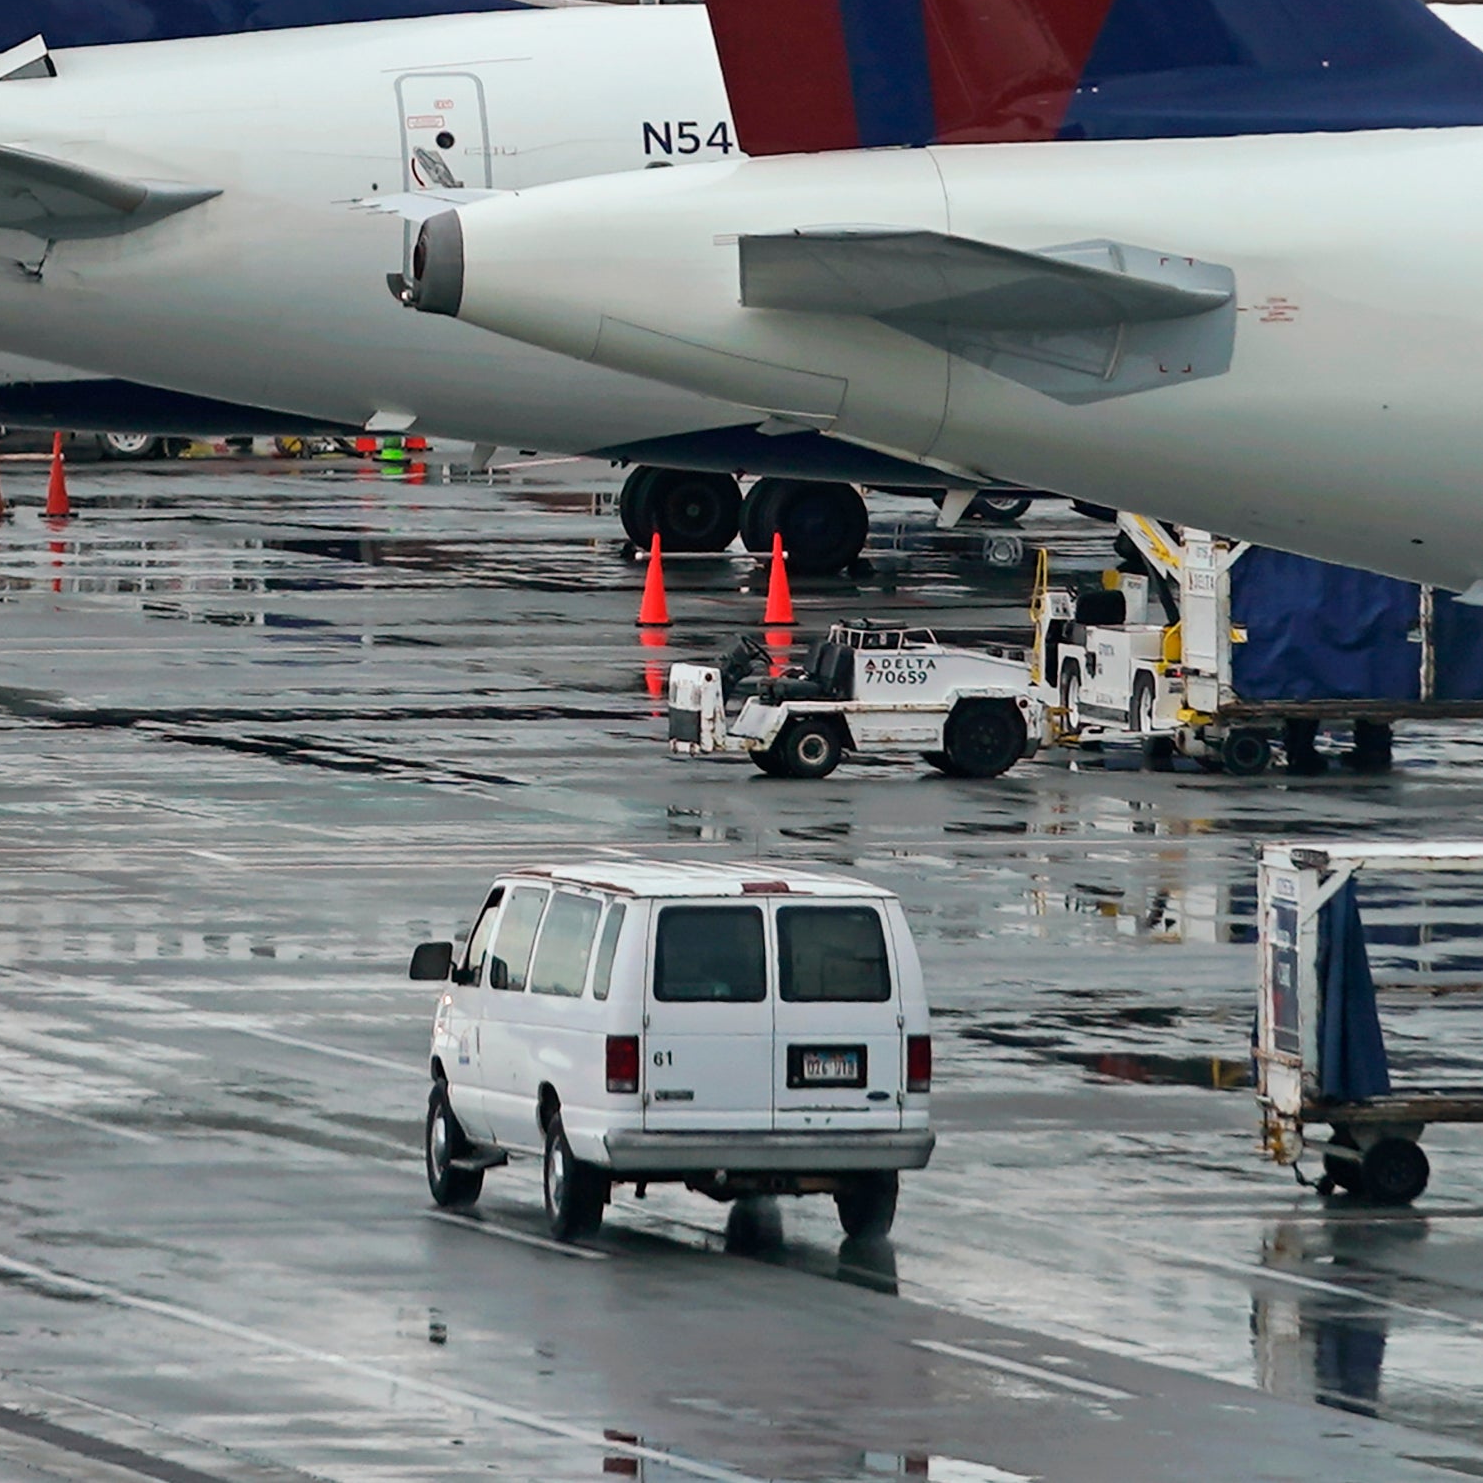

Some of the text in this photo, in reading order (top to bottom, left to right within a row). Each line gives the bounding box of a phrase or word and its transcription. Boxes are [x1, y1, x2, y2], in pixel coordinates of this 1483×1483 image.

[642, 121, 734, 155] N54
[881, 658, 937, 670] DELTA
[865, 670, 928, 684] 770659
[653, 1050, 674, 1067] 61
